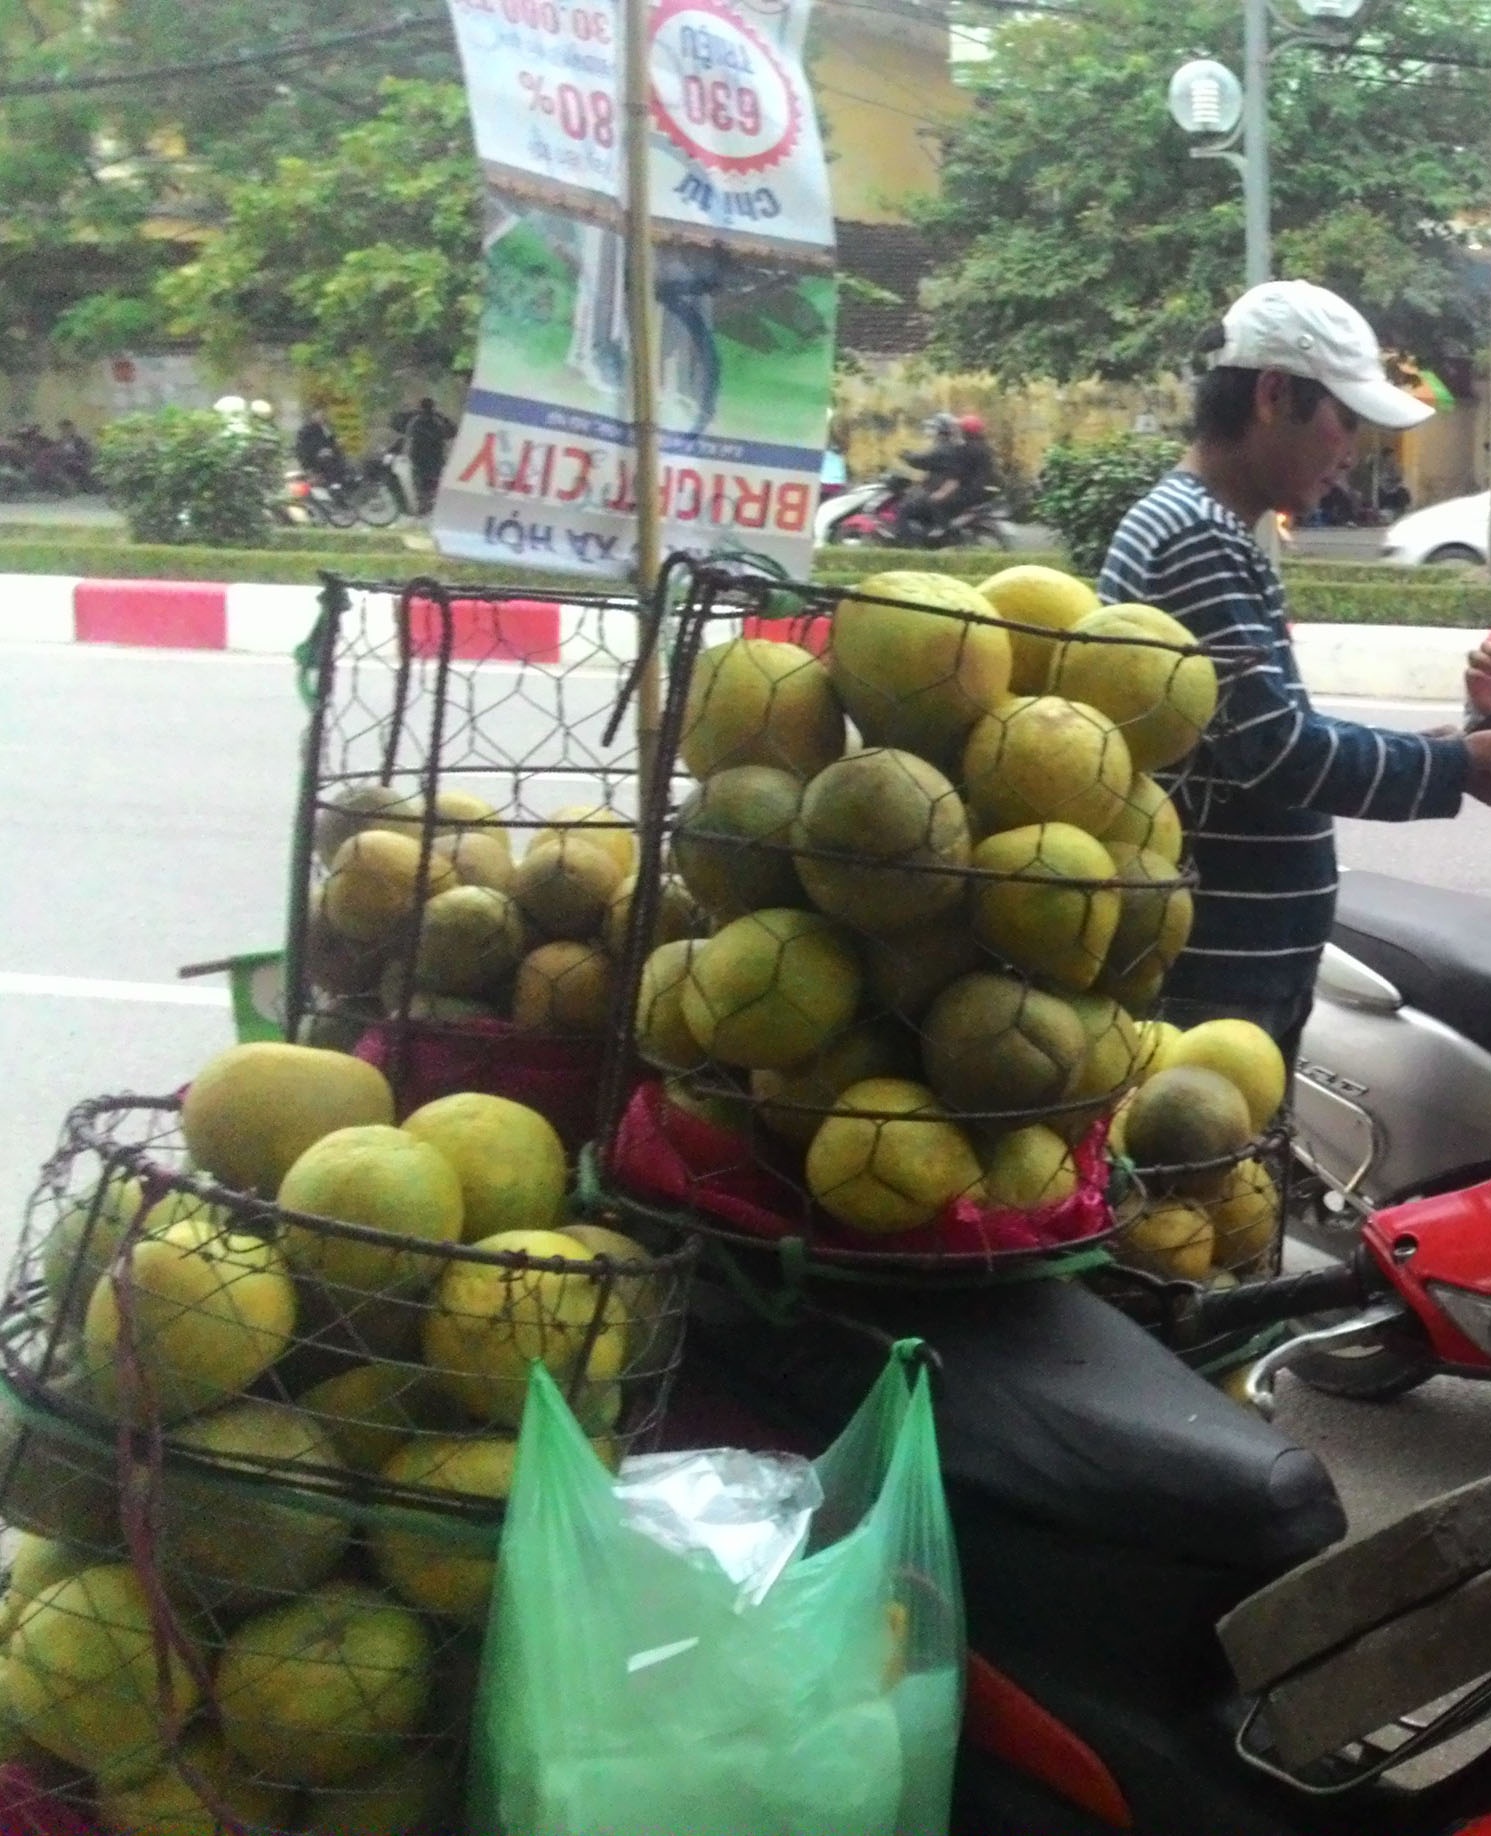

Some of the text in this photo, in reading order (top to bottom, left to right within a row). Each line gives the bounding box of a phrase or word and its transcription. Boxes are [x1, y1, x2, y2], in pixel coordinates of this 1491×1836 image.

[516, 71, 614, 149] 80%
[682, 75, 762, 137] 630
[459, 431, 596, 501] CITY
[483, 510, 553, 554] HỘI
